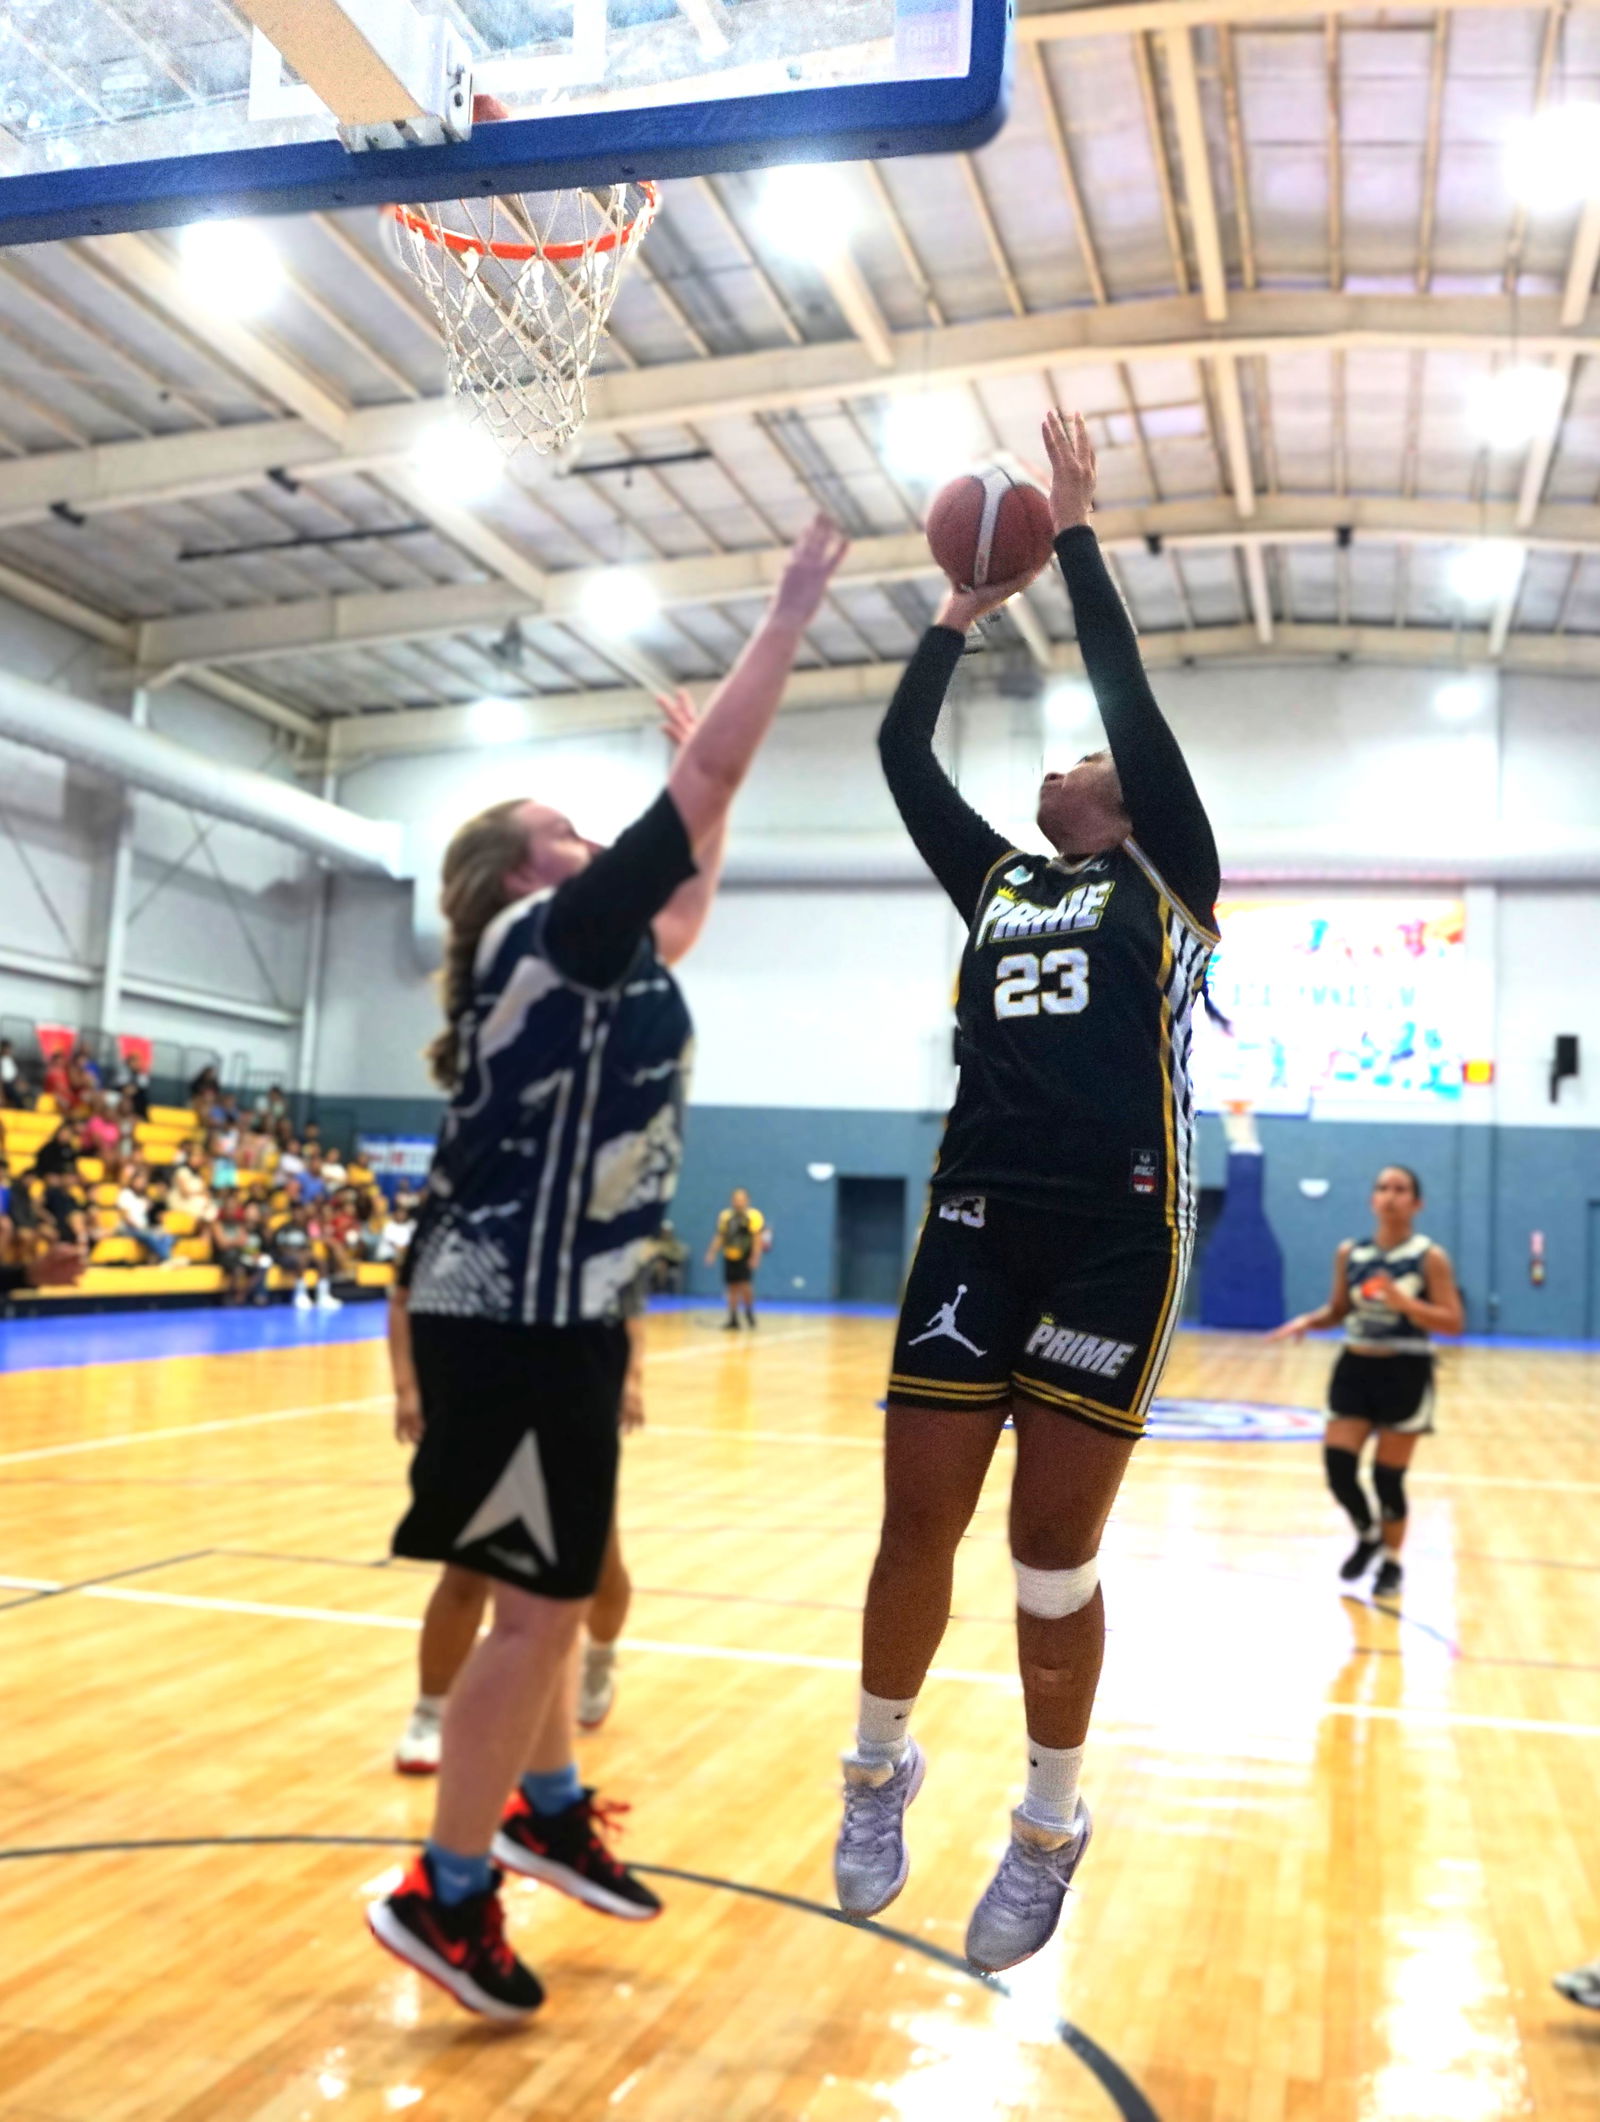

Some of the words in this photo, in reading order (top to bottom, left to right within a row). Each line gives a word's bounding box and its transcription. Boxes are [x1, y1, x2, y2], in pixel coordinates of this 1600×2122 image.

[975, 881, 1116, 951] PRIME
[994, 947, 1090, 1020] 23
[1025, 1323, 1138, 1379] PRIME
